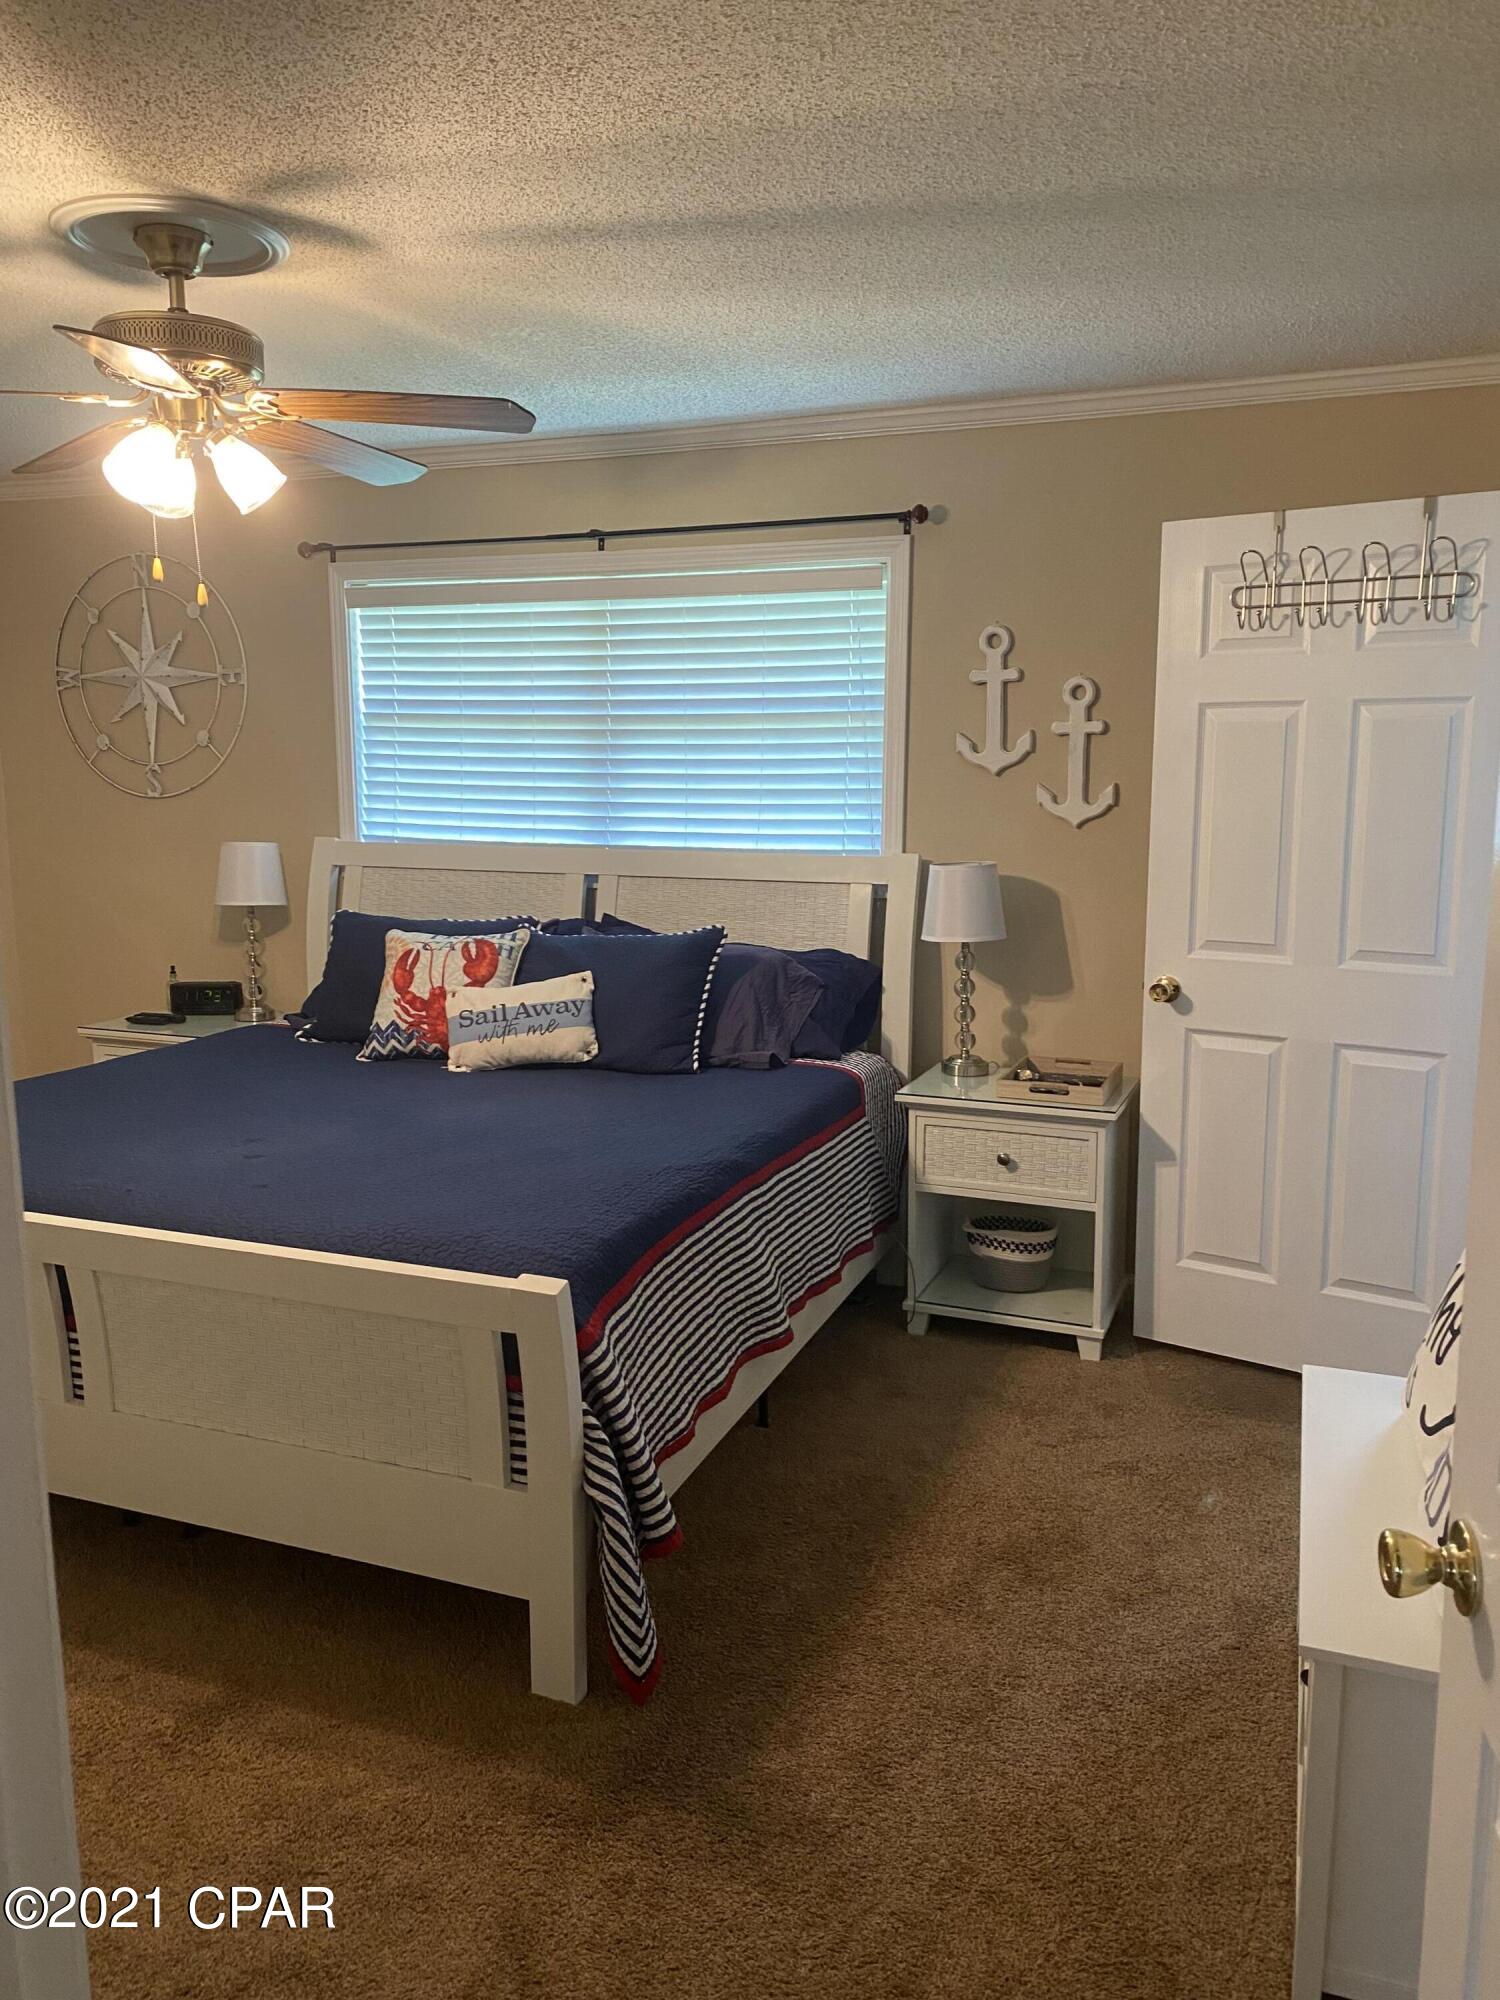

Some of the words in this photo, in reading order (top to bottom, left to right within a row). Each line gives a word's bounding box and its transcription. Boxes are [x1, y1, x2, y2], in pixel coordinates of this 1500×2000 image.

[145, 764, 163, 797] S
[458, 1003, 508, 1029] Sail
[513, 999, 586, 1020] Away
[477, 1018, 519, 1044] with
[526, 1017, 559, 1036] me
